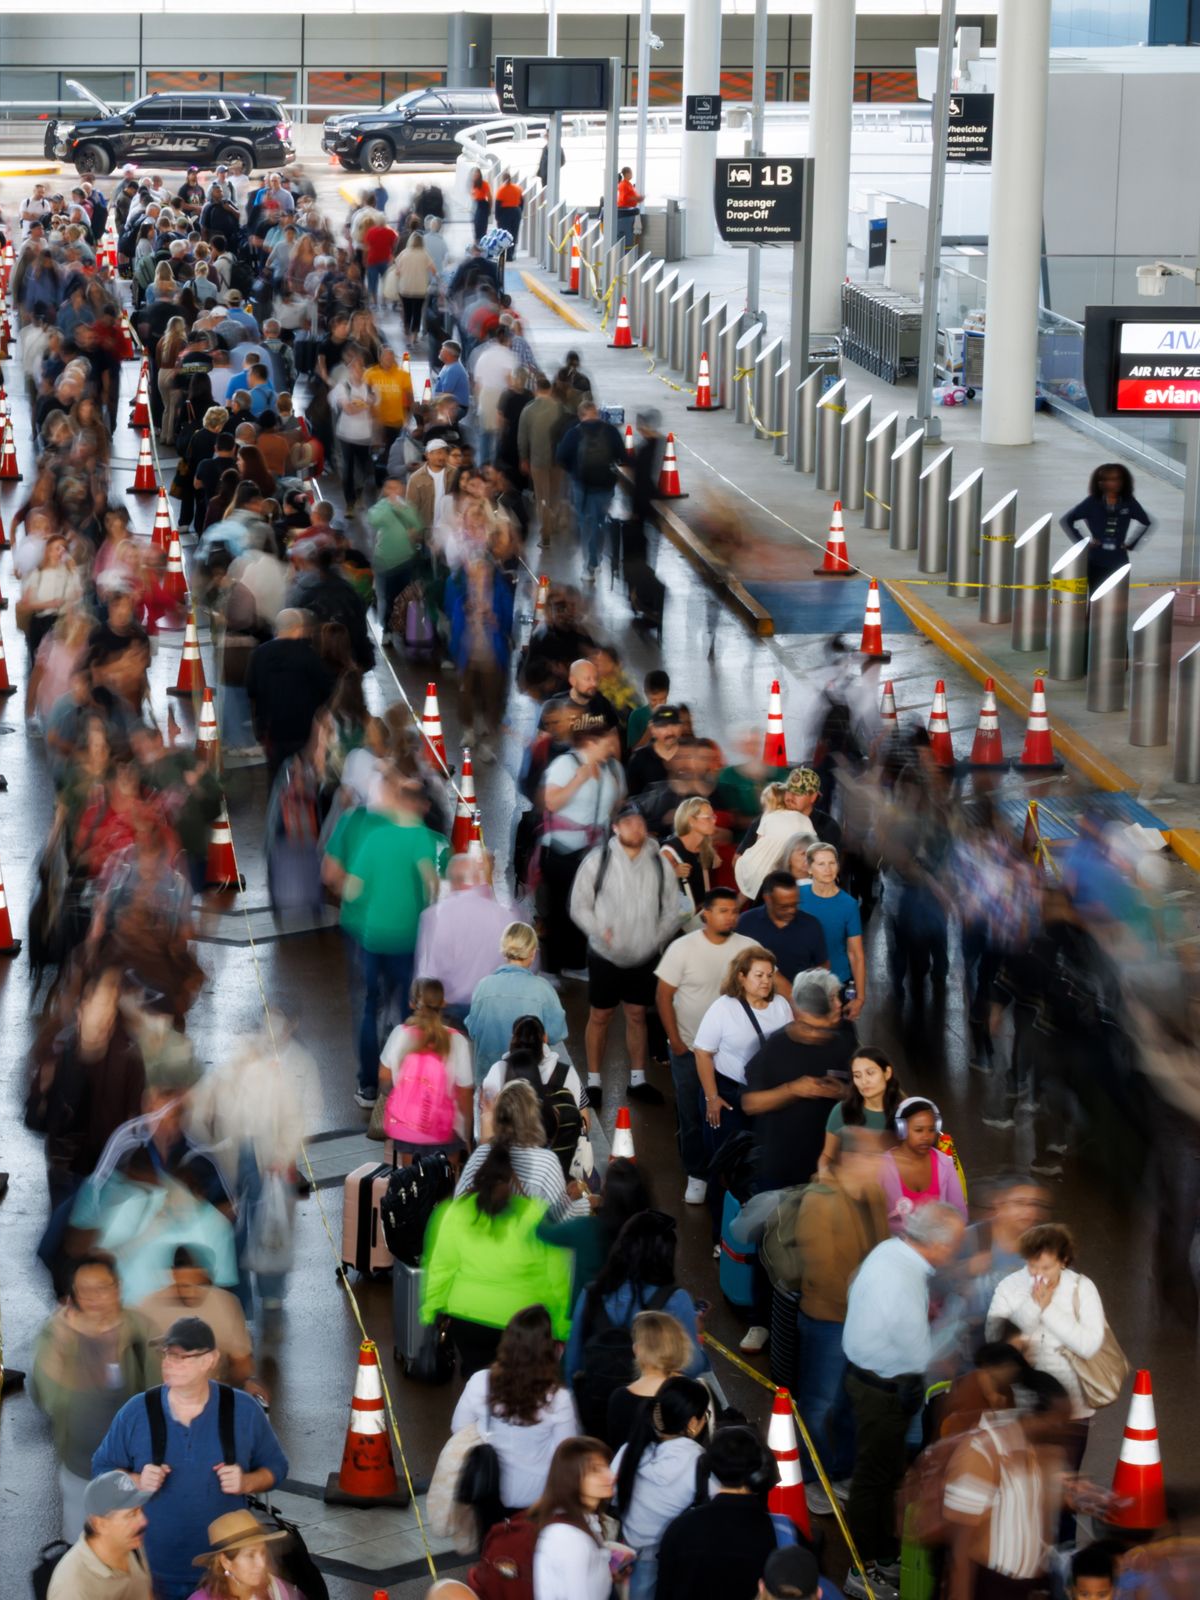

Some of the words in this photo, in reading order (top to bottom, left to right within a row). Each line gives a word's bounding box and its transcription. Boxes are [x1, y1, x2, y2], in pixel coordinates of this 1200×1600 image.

[131, 138, 210, 146] POLICE
[411, 132, 452, 141] POL
[947, 135, 984, 143] ssistance
[761, 165, 793, 186] 1B
[726, 198, 776, 209] Passenger
[726, 210, 769, 221] Drop-Off
[1157, 330, 1200, 350] AN
[1129, 365, 1153, 377] AIR
[1153, 366, 1184, 377] NEW
[1144, 385, 1200, 404] avian
